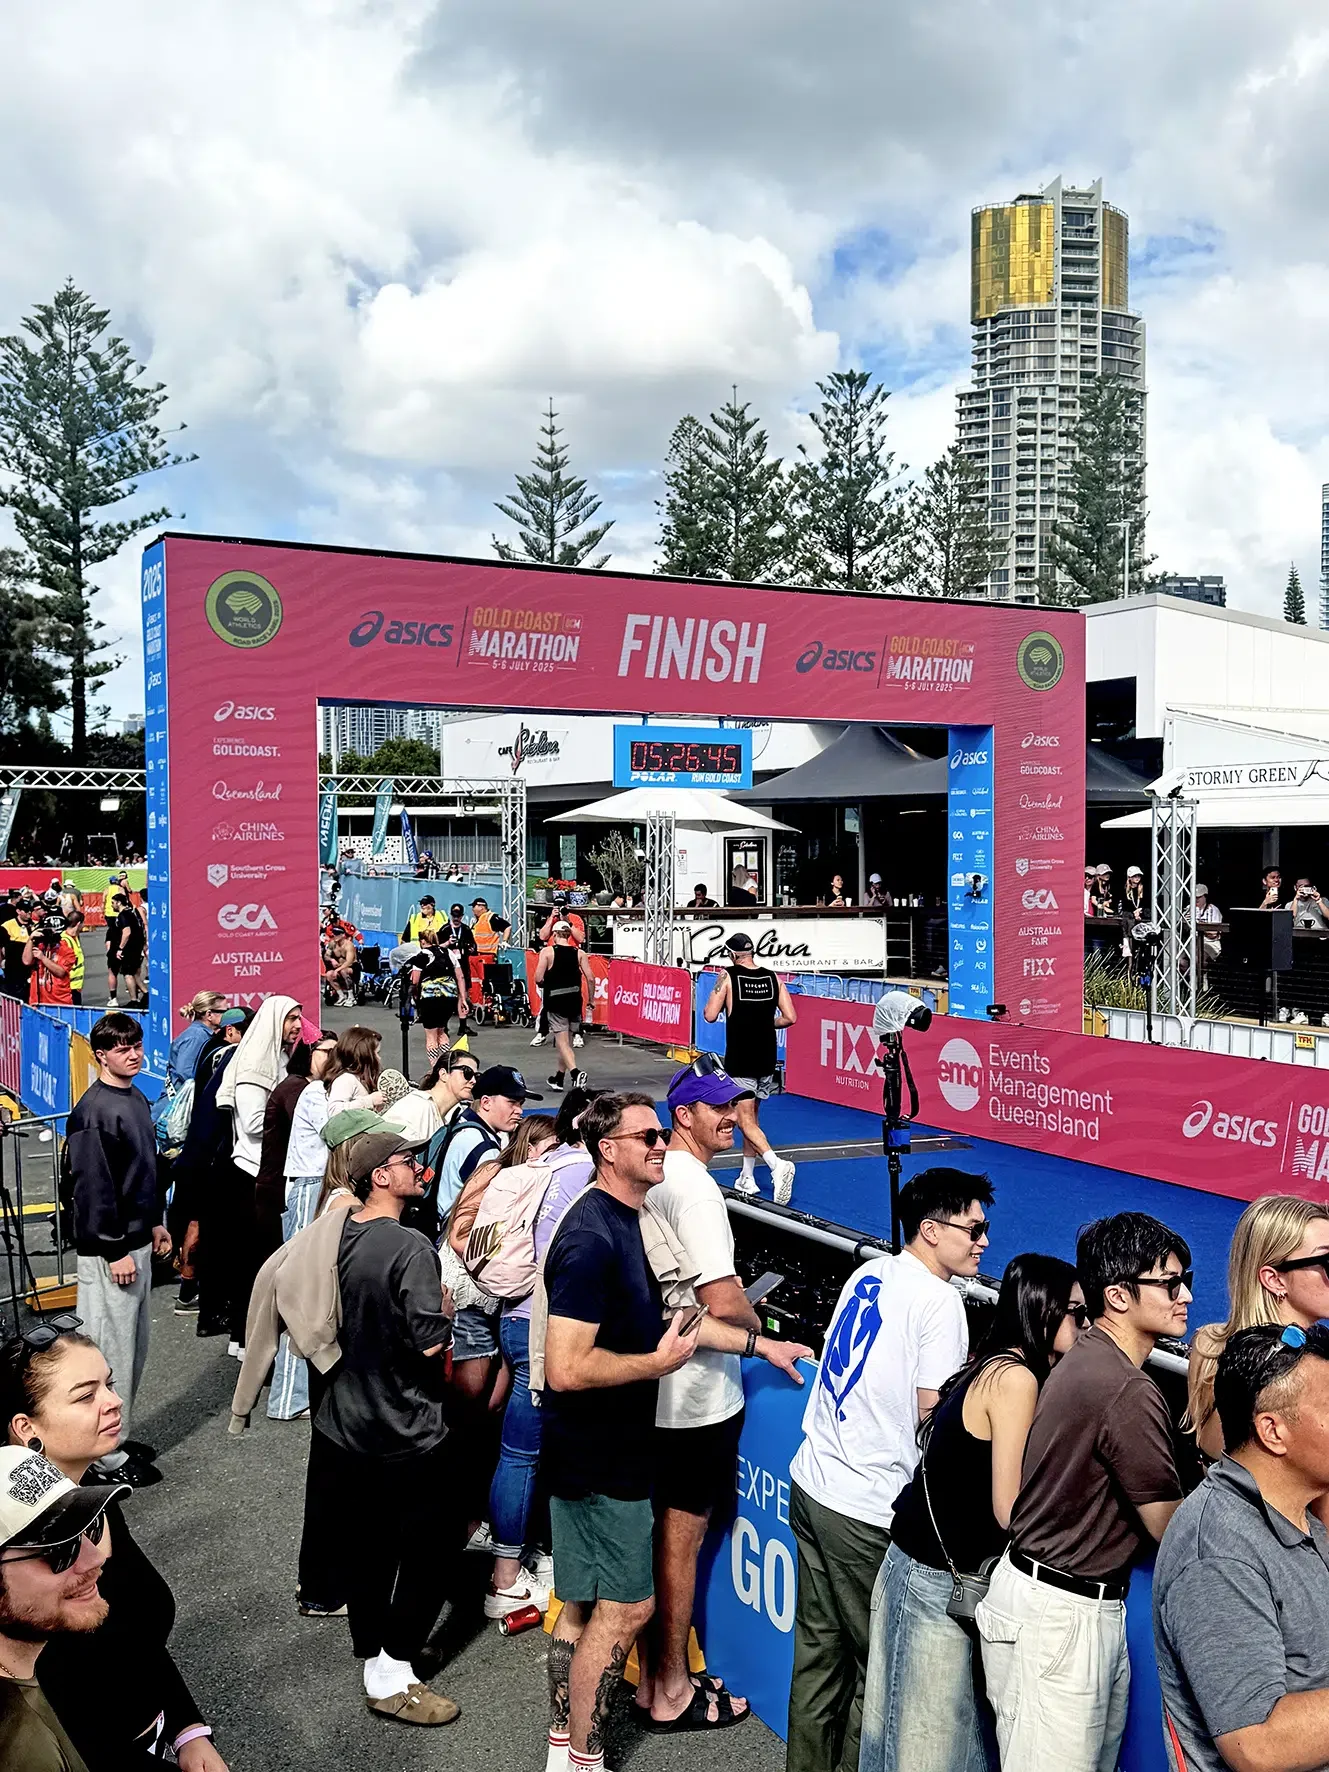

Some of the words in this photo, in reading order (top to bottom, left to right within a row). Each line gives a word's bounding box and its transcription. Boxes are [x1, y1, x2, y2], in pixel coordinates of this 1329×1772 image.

[143, 561, 162, 602] 2025
[227, 621, 262, 630] ATHLETICS
[473, 607, 514, 629] GOLD
[514, 610, 562, 632] COAST
[468, 629, 580, 663] MARATHON
[617, 613, 767, 684] FINISH
[890, 636, 920, 655] GOLD
[922, 638, 960, 657] COAST
[492, 661, 507, 670] 5-6
[509, 662, 530, 671] JULY
[532, 662, 554, 672] 2025
[886, 655, 974, 683] MARATHON
[904, 681, 916, 691] 5-6
[917, 682, 933, 691] JULY
[935, 683, 953, 692] 2025
[631, 742, 736, 772] 05:26:45
[630, 772, 676, 783] POLAR
[691, 772, 705, 783] RUN
[705, 773, 721, 783] GOLD
[722, 773, 742, 783] COAST
[1187, 769, 1243, 786] STORMY
[1248, 767, 1297, 784] GREEN
[212, 780, 282, 802] Queensland
[1019, 793, 1063, 810] Queensland
[239, 822, 277, 832] CHINA
[320, 795, 334, 847] MEDIA
[233, 831, 285, 841] AIRLINES
[1032, 833, 1064, 841] AIRLINES
[230, 864, 264, 872] Southern
[230, 872, 268, 880] University
[1021, 888, 1059, 910] GCA
[217, 903, 278, 930] GCA
[1018, 926, 1062, 936] AUSTRALIA
[690, 925, 812, 965] Calina
[1031, 937, 1048, 946] FAIR
[211, 951, 284, 964] AUSTRALIA
[773, 959, 838, 967] RESTAURANT
[853, 958, 874, 966] BAR
[1023, 957, 1056, 976] FIXX
[234, 965, 261, 976] FAIR
[643, 983, 656, 999] GOLD
[656, 984, 675, 1002] COAST
[641, 999, 681, 1025] MARATHON
[820, 1018, 886, 1080] FIXX
[989, 1043, 1050, 1075] Events
[835, 1075, 870, 1091] NUTRITION
[989, 1070, 1114, 1115] Management
[989, 1096, 1100, 1141] Queensland
[735, 1454, 790, 1526] EXPE
[731, 1516, 796, 1633] GO
